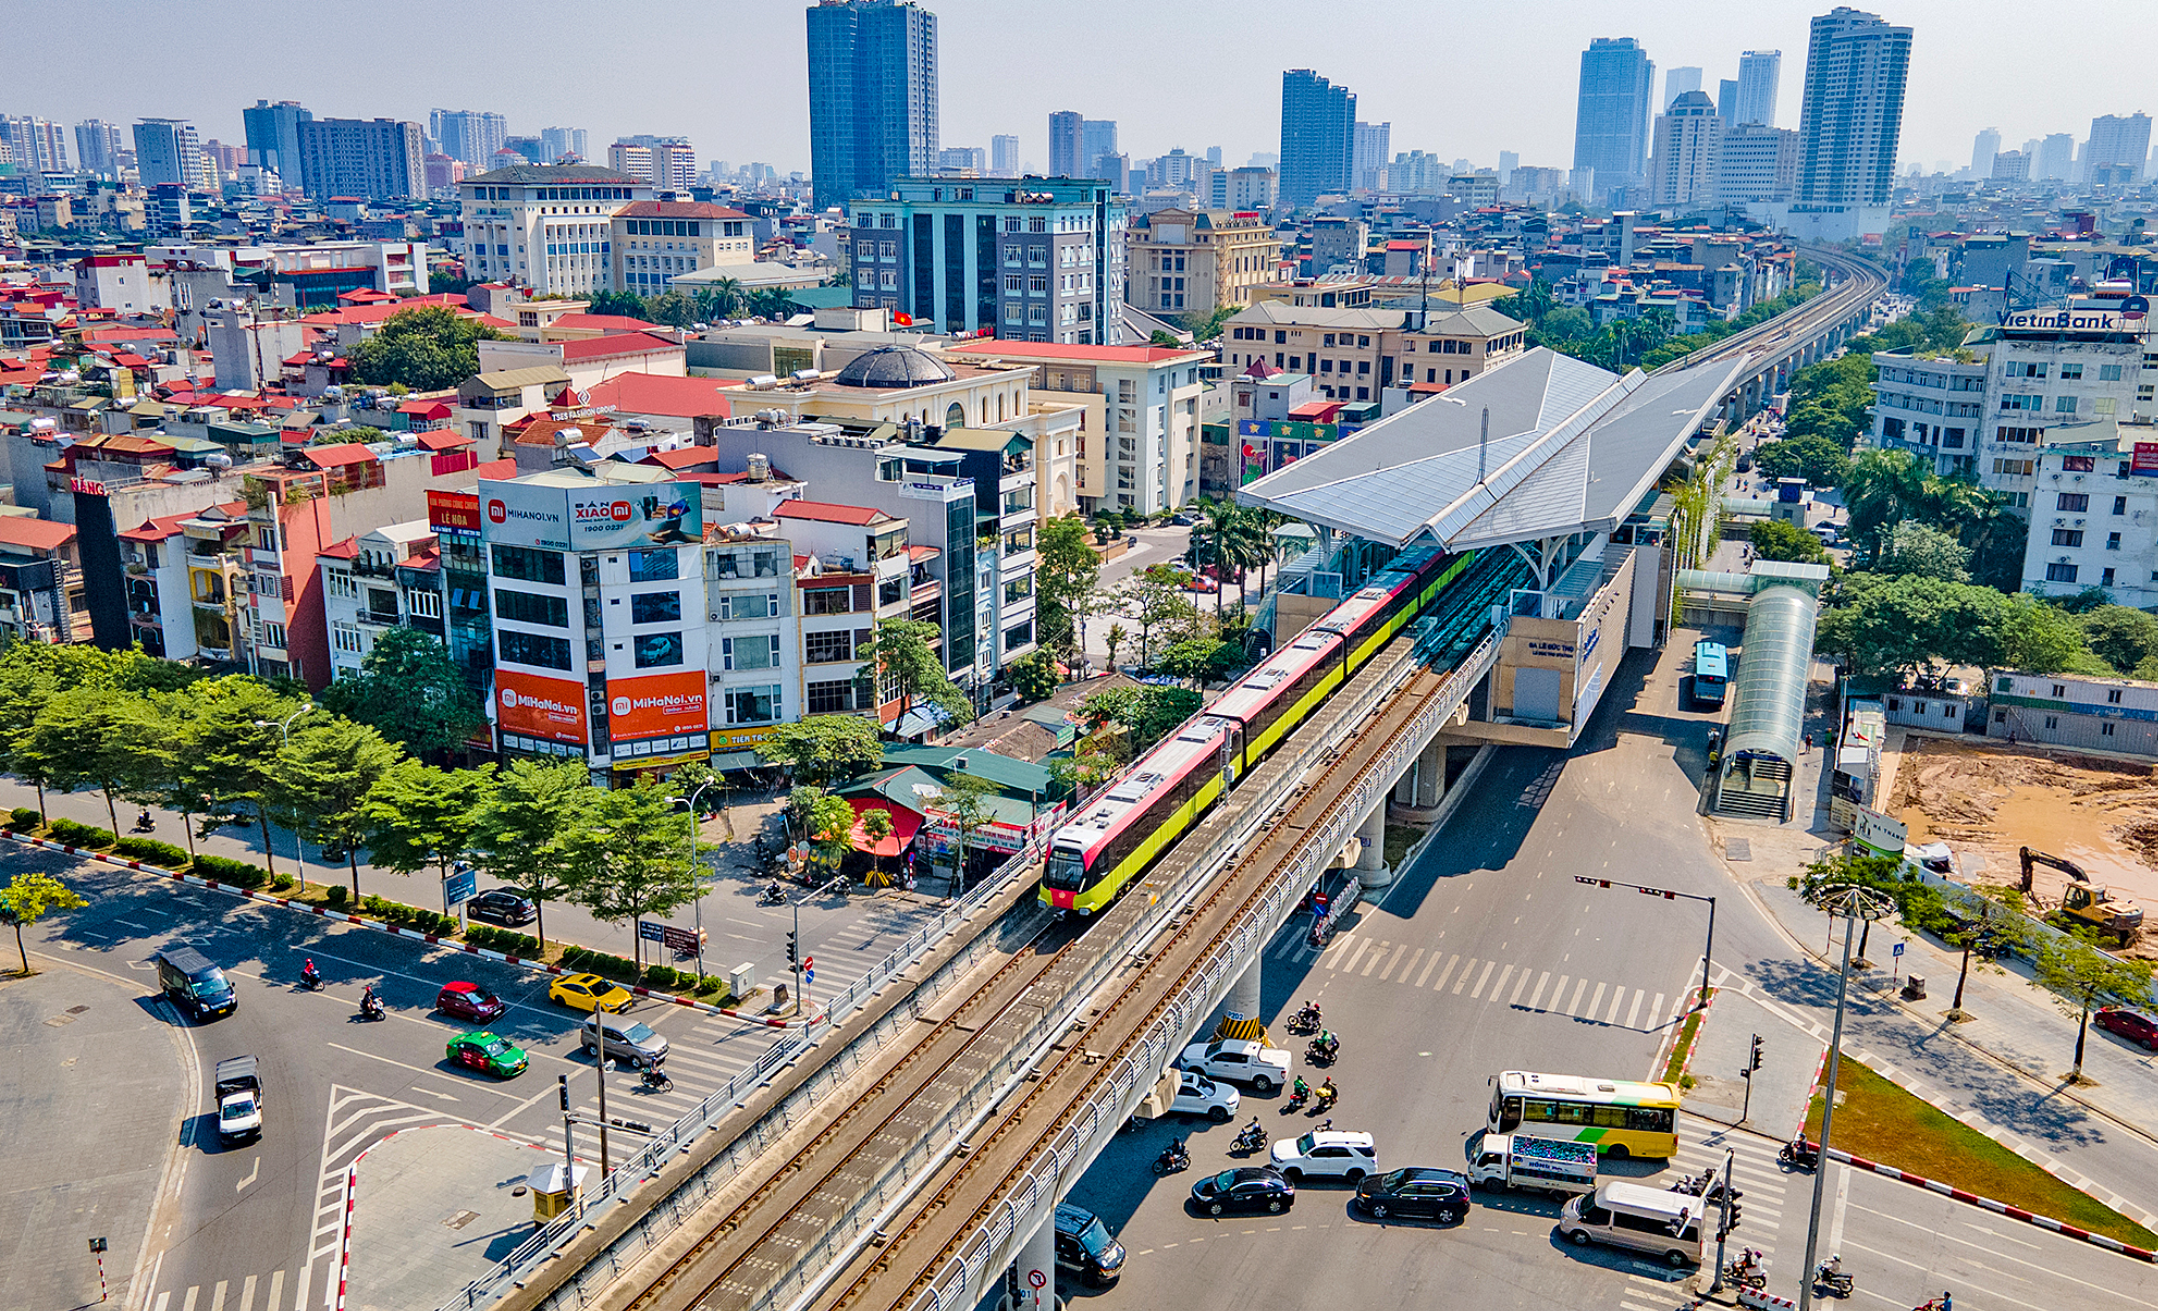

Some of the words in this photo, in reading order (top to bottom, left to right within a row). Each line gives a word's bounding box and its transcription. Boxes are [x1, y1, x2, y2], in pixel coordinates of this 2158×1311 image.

[1996, 310, 2115, 329] VietinBank
[507, 508, 559, 522] MIHANOI.VN
[576, 508, 610, 518] XIAO
[518, 694, 577, 714] MiHaNoi.vn
[633, 694, 703, 709] MiHaNoi.vn
